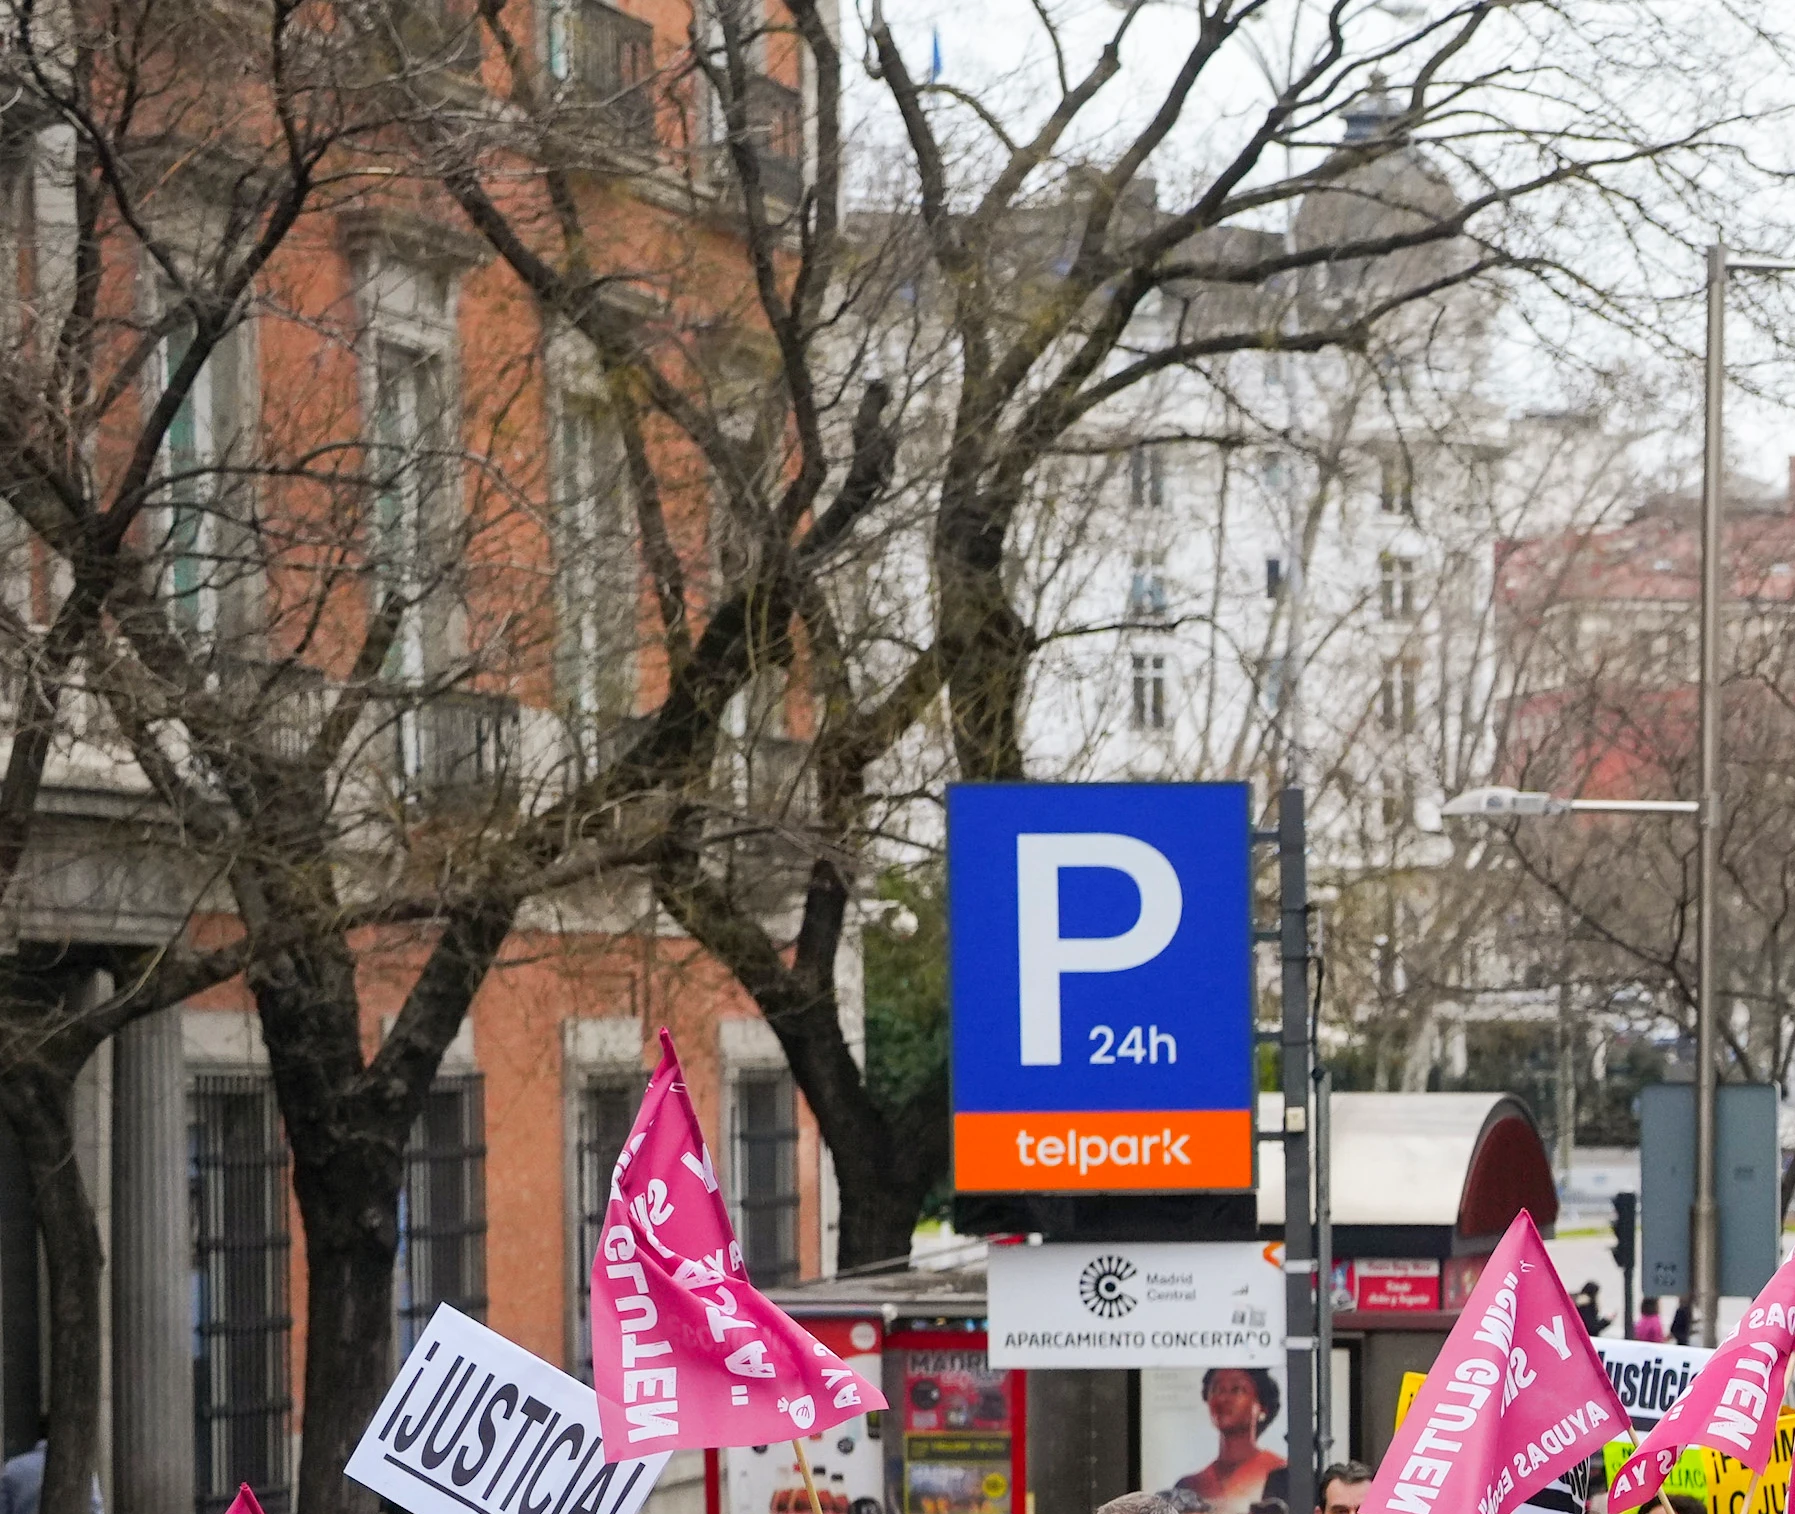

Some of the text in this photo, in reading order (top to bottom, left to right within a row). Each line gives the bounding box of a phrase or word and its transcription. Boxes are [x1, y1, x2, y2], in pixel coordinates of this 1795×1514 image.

[1016, 832, 1184, 1067] P
[1087, 1025, 1178, 1065] 24h
[1016, 1129, 1191, 1175] telpark
[1146, 1271, 1194, 1287] Madrid
[1146, 1288, 1197, 1303] Central
[1004, 1330, 1147, 1350] APARCAMIENTO
